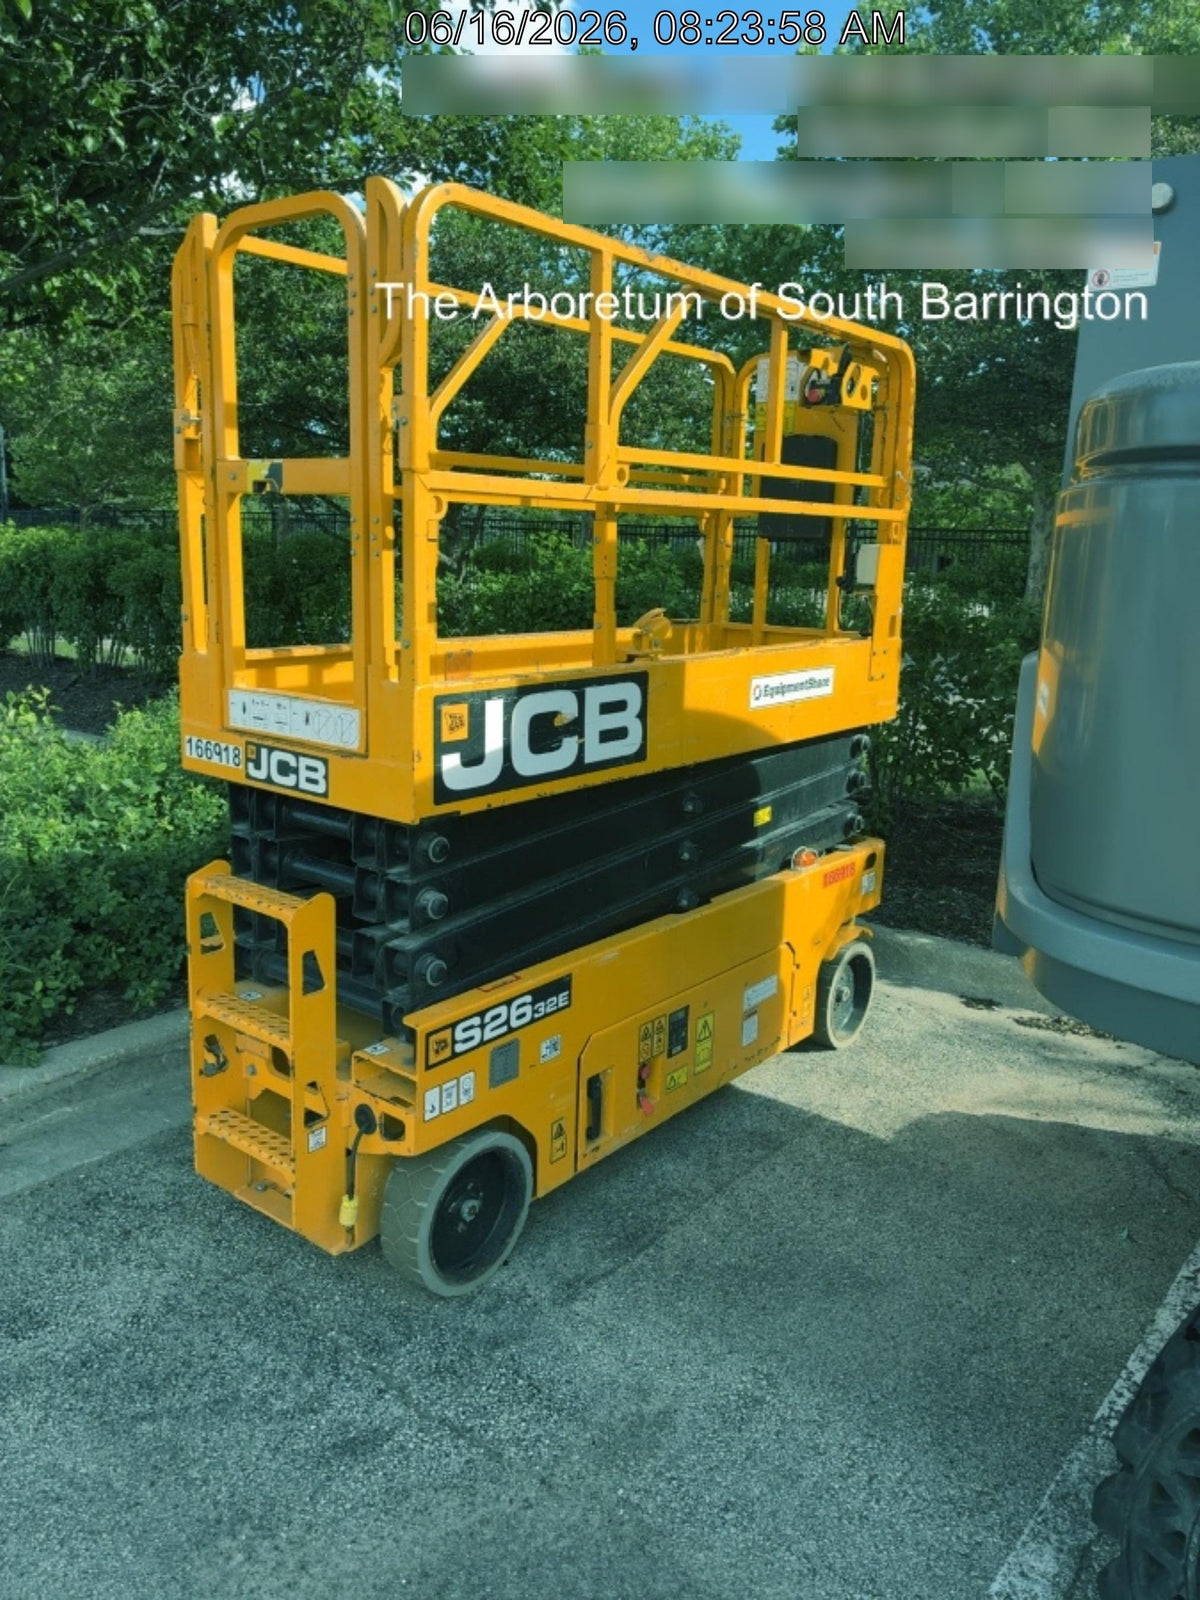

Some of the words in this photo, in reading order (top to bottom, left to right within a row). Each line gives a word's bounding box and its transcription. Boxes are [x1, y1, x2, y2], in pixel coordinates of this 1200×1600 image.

[762, 677, 830, 699] EquipmentShare
[186, 736, 242, 768] 166918
[441, 682, 643, 791] JCB
[247, 747, 327, 794] JCB
